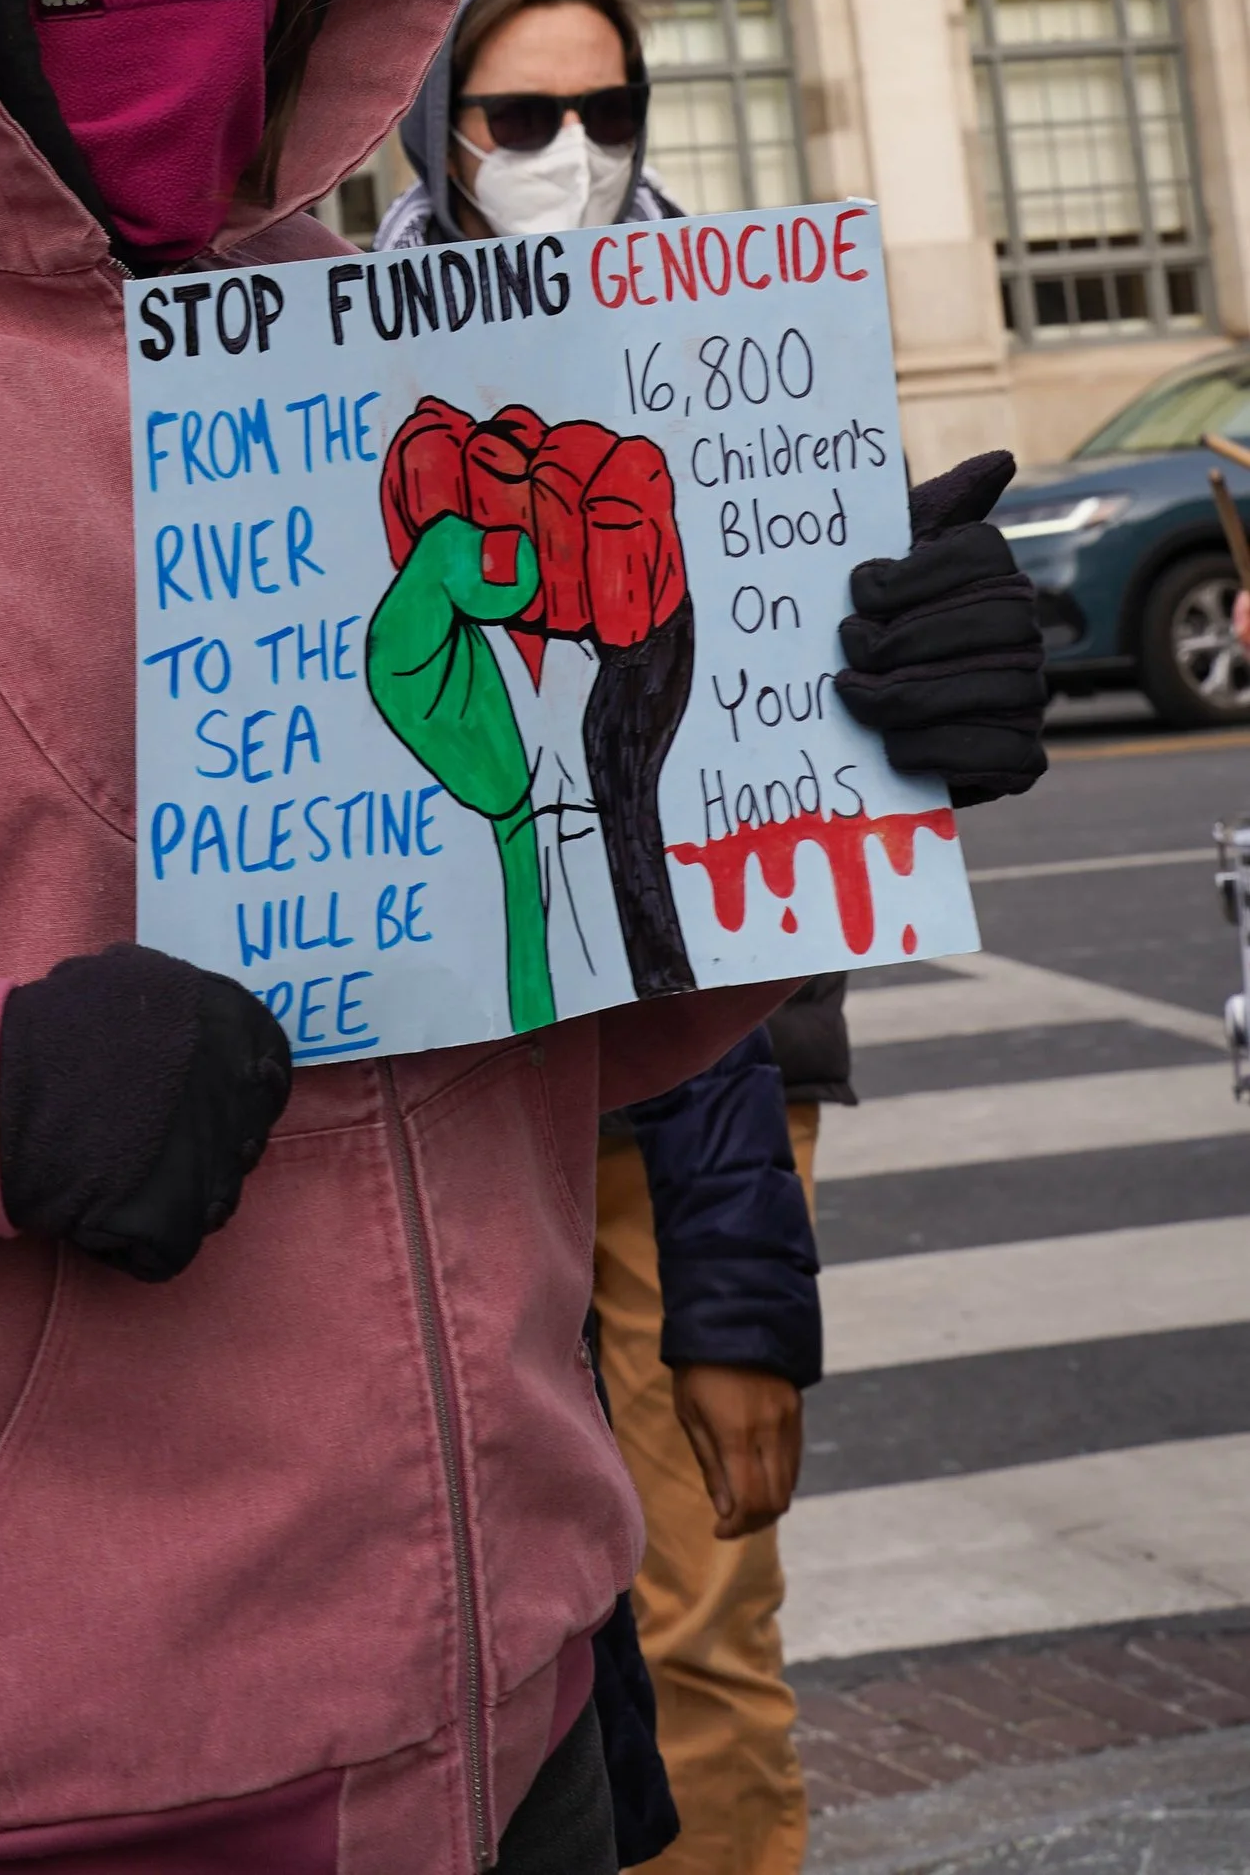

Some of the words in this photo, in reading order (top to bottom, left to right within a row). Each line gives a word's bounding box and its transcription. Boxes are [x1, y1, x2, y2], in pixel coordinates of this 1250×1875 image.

[138, 273, 284, 361] STOP
[327, 235, 571, 346] FUNDING
[590, 208, 871, 310] GENOCIDE
[624, 328, 813, 417] 16,800
[146, 397, 280, 493] FROM
[286, 391, 382, 473] THE
[691, 419, 886, 488] Children's
[155, 505, 326, 610] RIVER
[720, 488, 848, 558] Blood
[731, 585, 800, 634] On
[143, 636, 231, 699] TO
[254, 615, 362, 685] THE
[195, 704, 321, 784] SEA
[712, 668, 840, 743] Your
[150, 784, 445, 880] PALESTINE
[700, 749, 865, 840] Hands
[237, 891, 354, 967] WILL
[376, 881, 433, 951] BE
[253, 970, 375, 1043] REE
